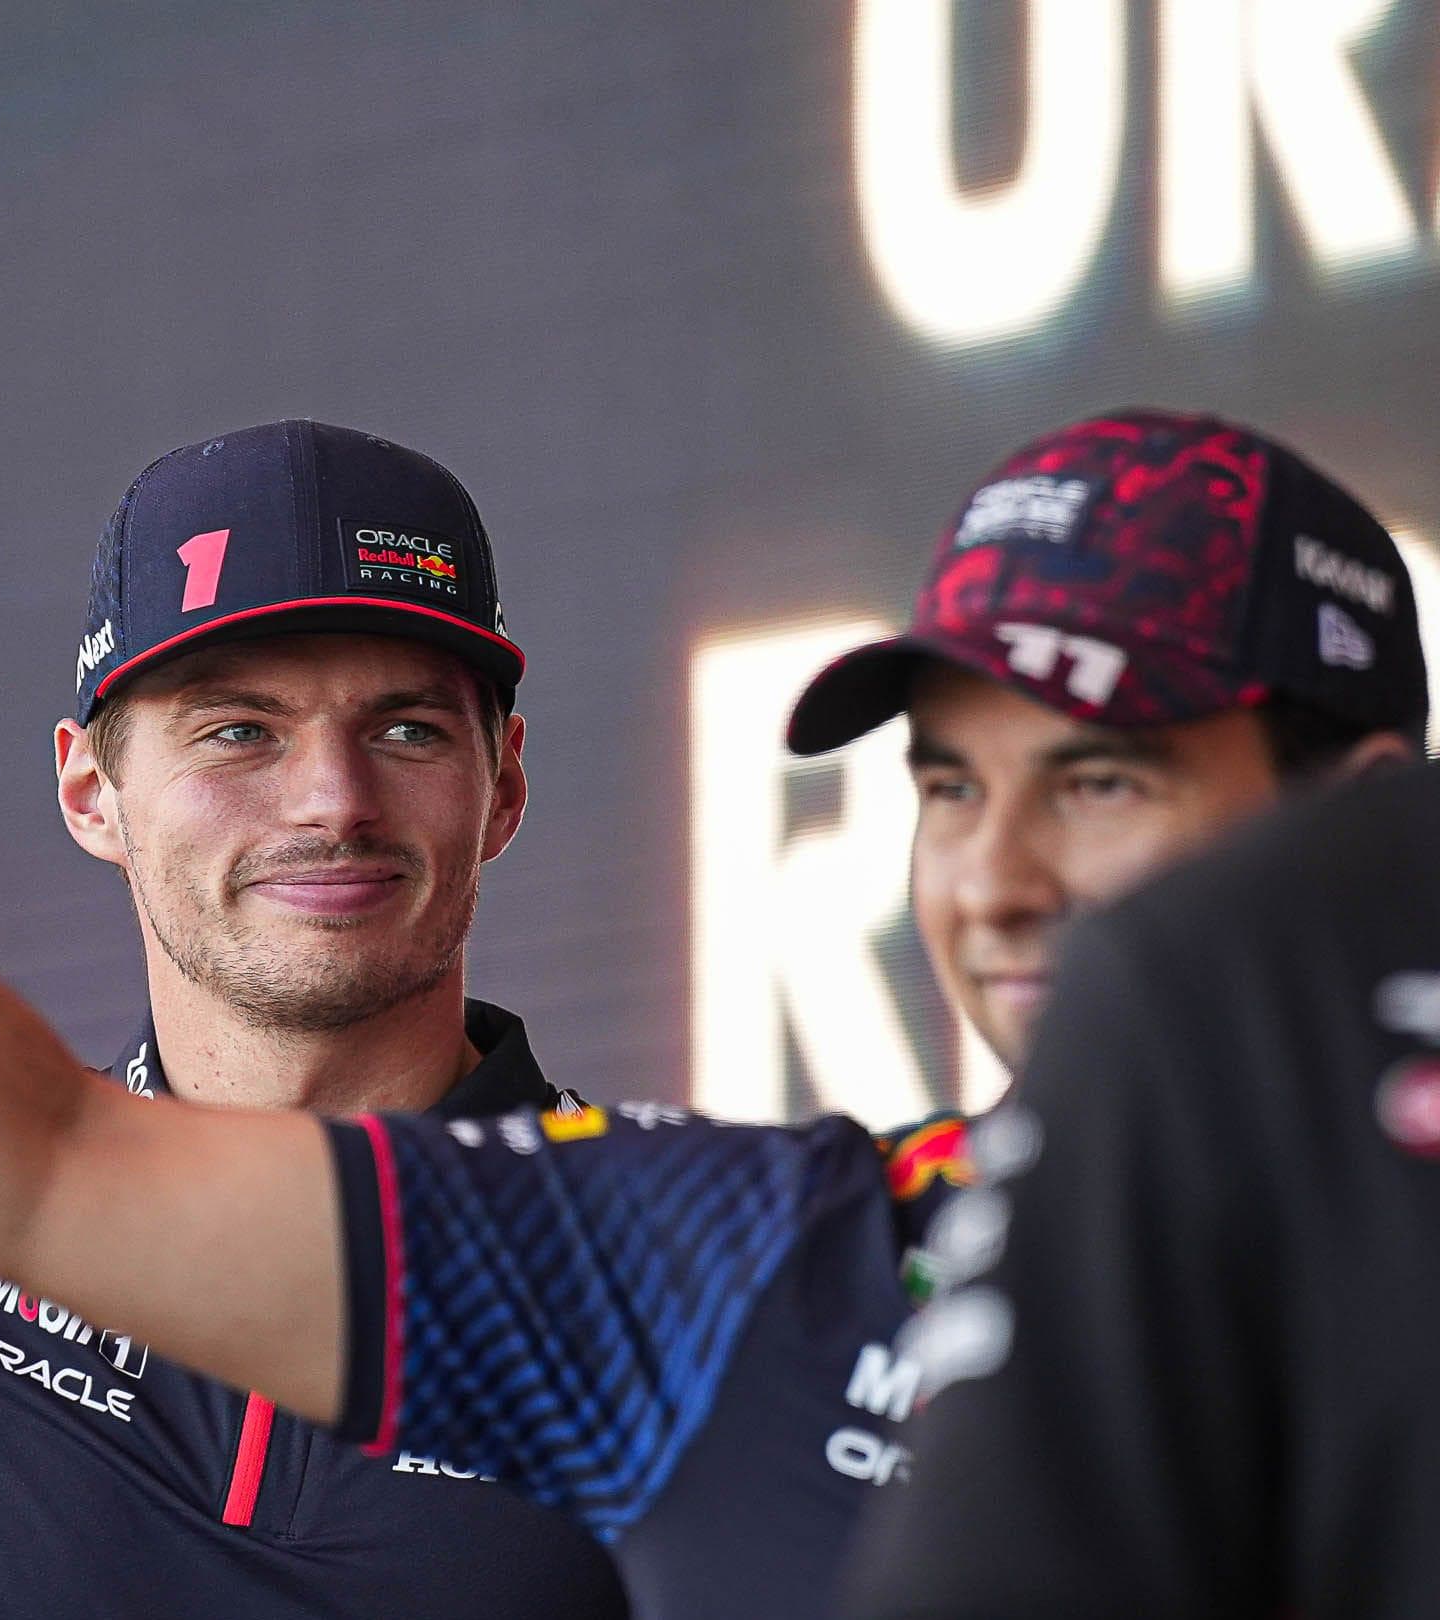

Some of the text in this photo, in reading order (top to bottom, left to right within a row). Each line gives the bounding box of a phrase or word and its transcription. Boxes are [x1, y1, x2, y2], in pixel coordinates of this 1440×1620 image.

[177, 529, 230, 612] 1
[356, 529, 453, 559] ORACLE
[360, 569, 457, 595] RACING
[994, 622, 1127, 707] 11
